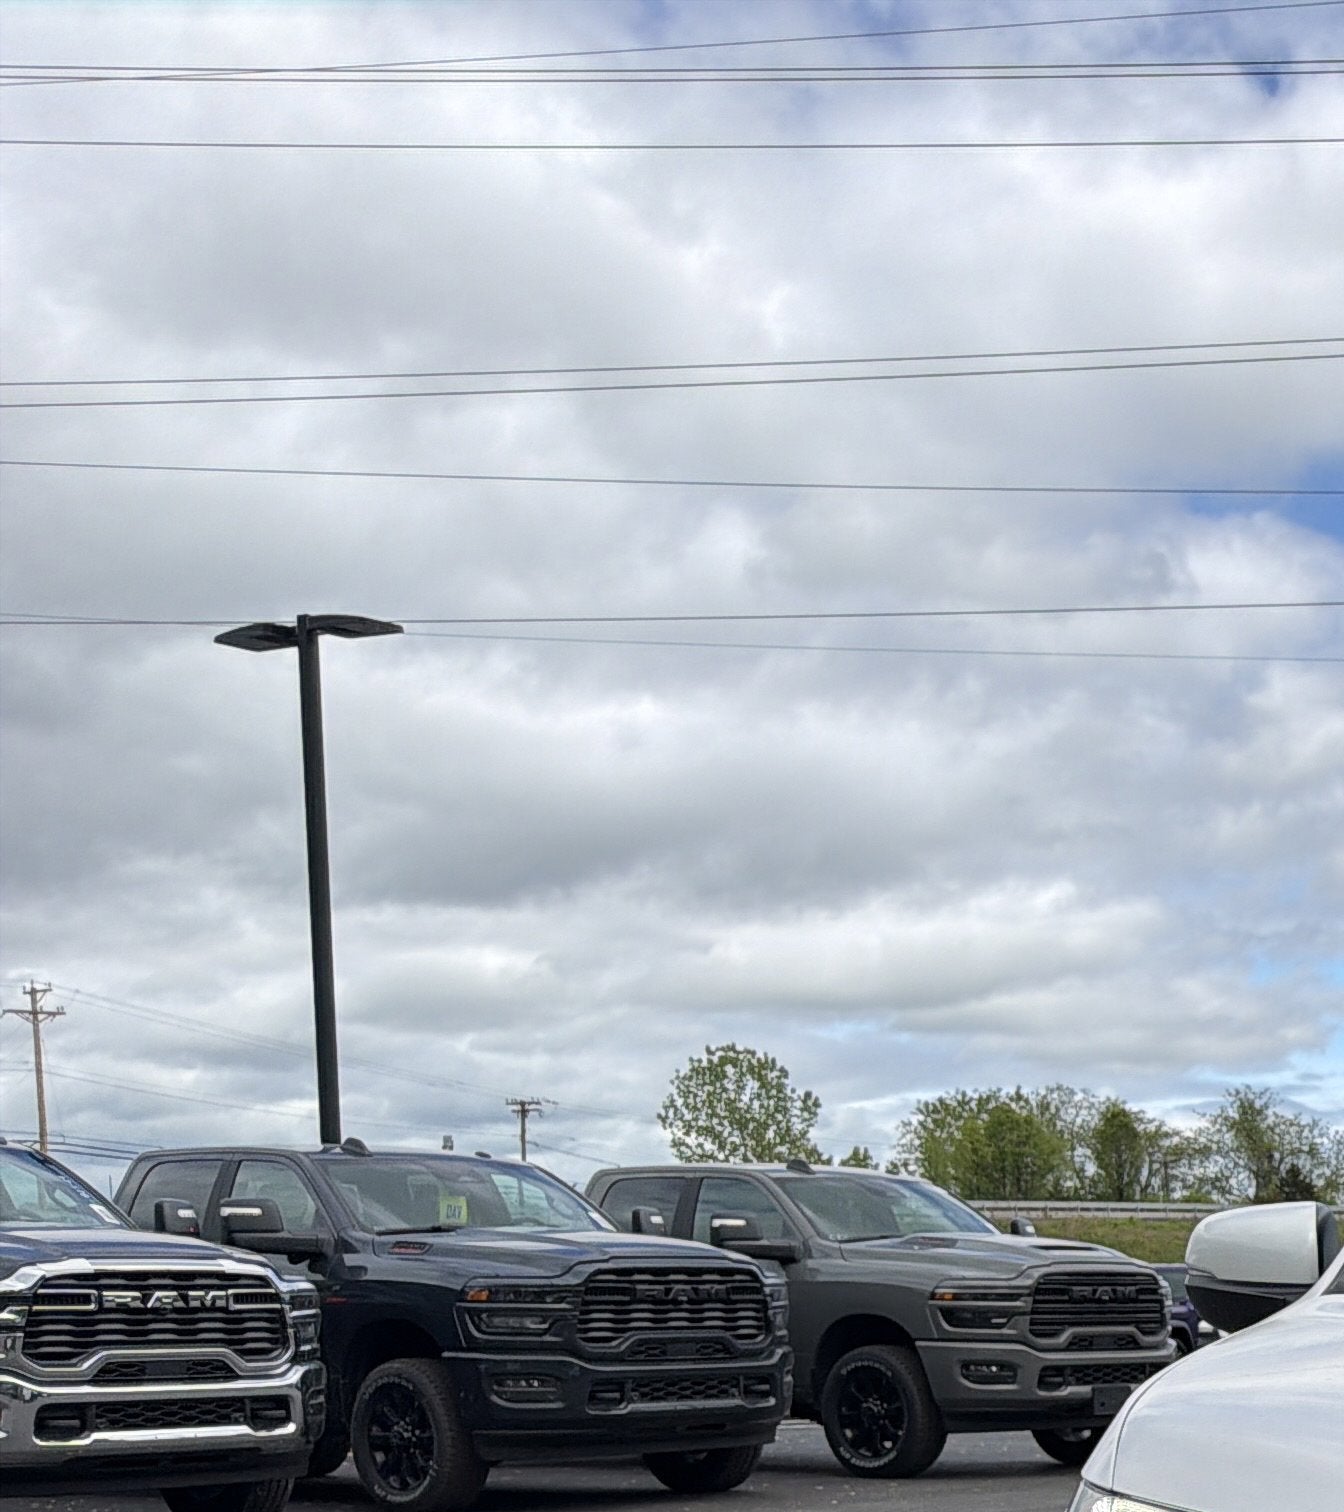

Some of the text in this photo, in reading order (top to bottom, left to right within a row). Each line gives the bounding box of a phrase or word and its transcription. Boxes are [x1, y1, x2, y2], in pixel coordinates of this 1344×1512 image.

[102, 1290, 227, 1309] RAM
[635, 1284, 727, 1301] RAM
[1072, 1286, 1137, 1300] RAM
